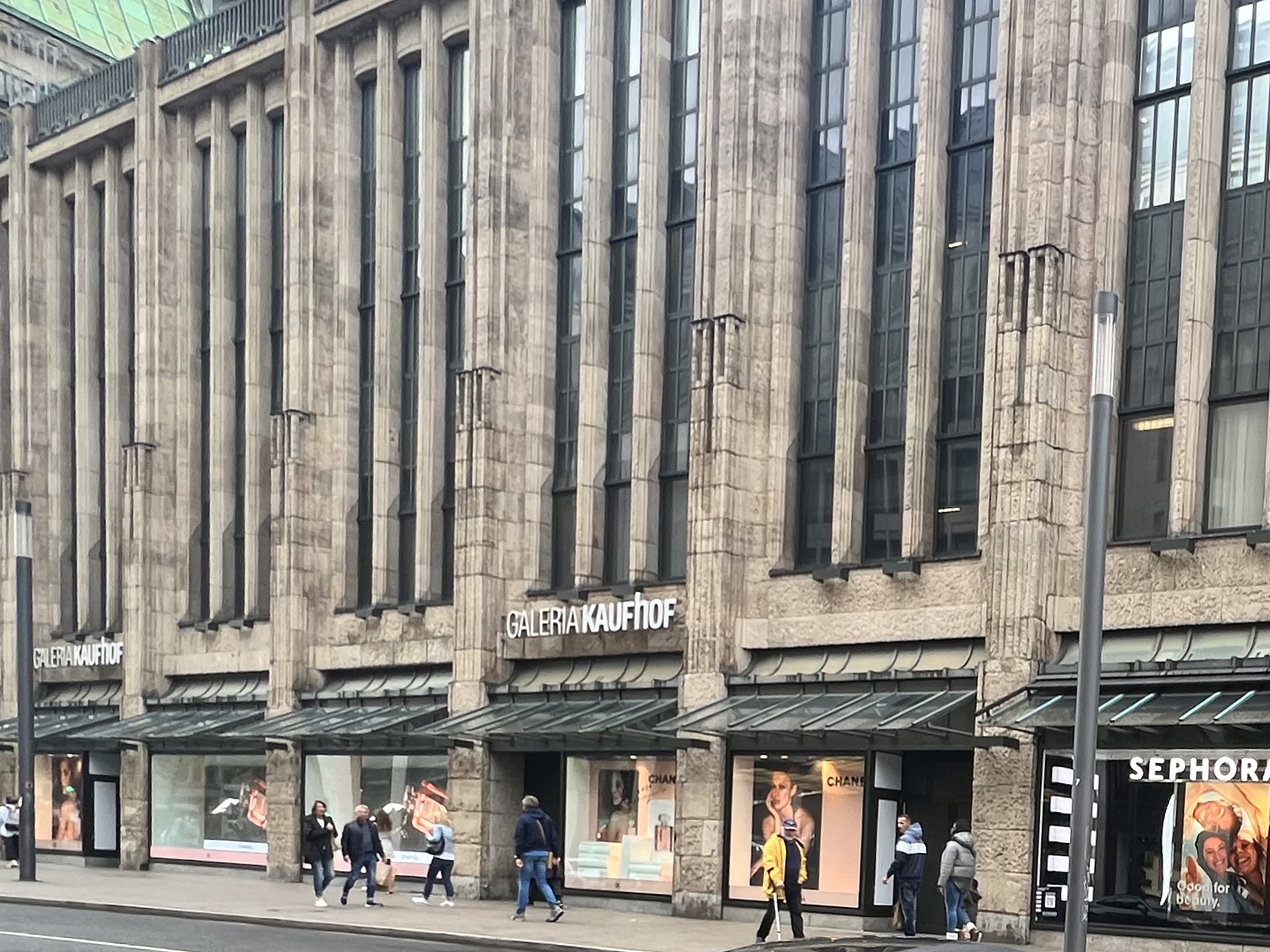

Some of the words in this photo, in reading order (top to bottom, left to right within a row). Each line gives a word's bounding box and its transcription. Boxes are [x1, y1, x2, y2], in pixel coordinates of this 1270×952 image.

[506, 606, 580, 639] GALERIA
[33, 645, 72, 669] GALERIA
[1213, 881, 1230, 894] for
[1176, 894, 1221, 909] beauty.
